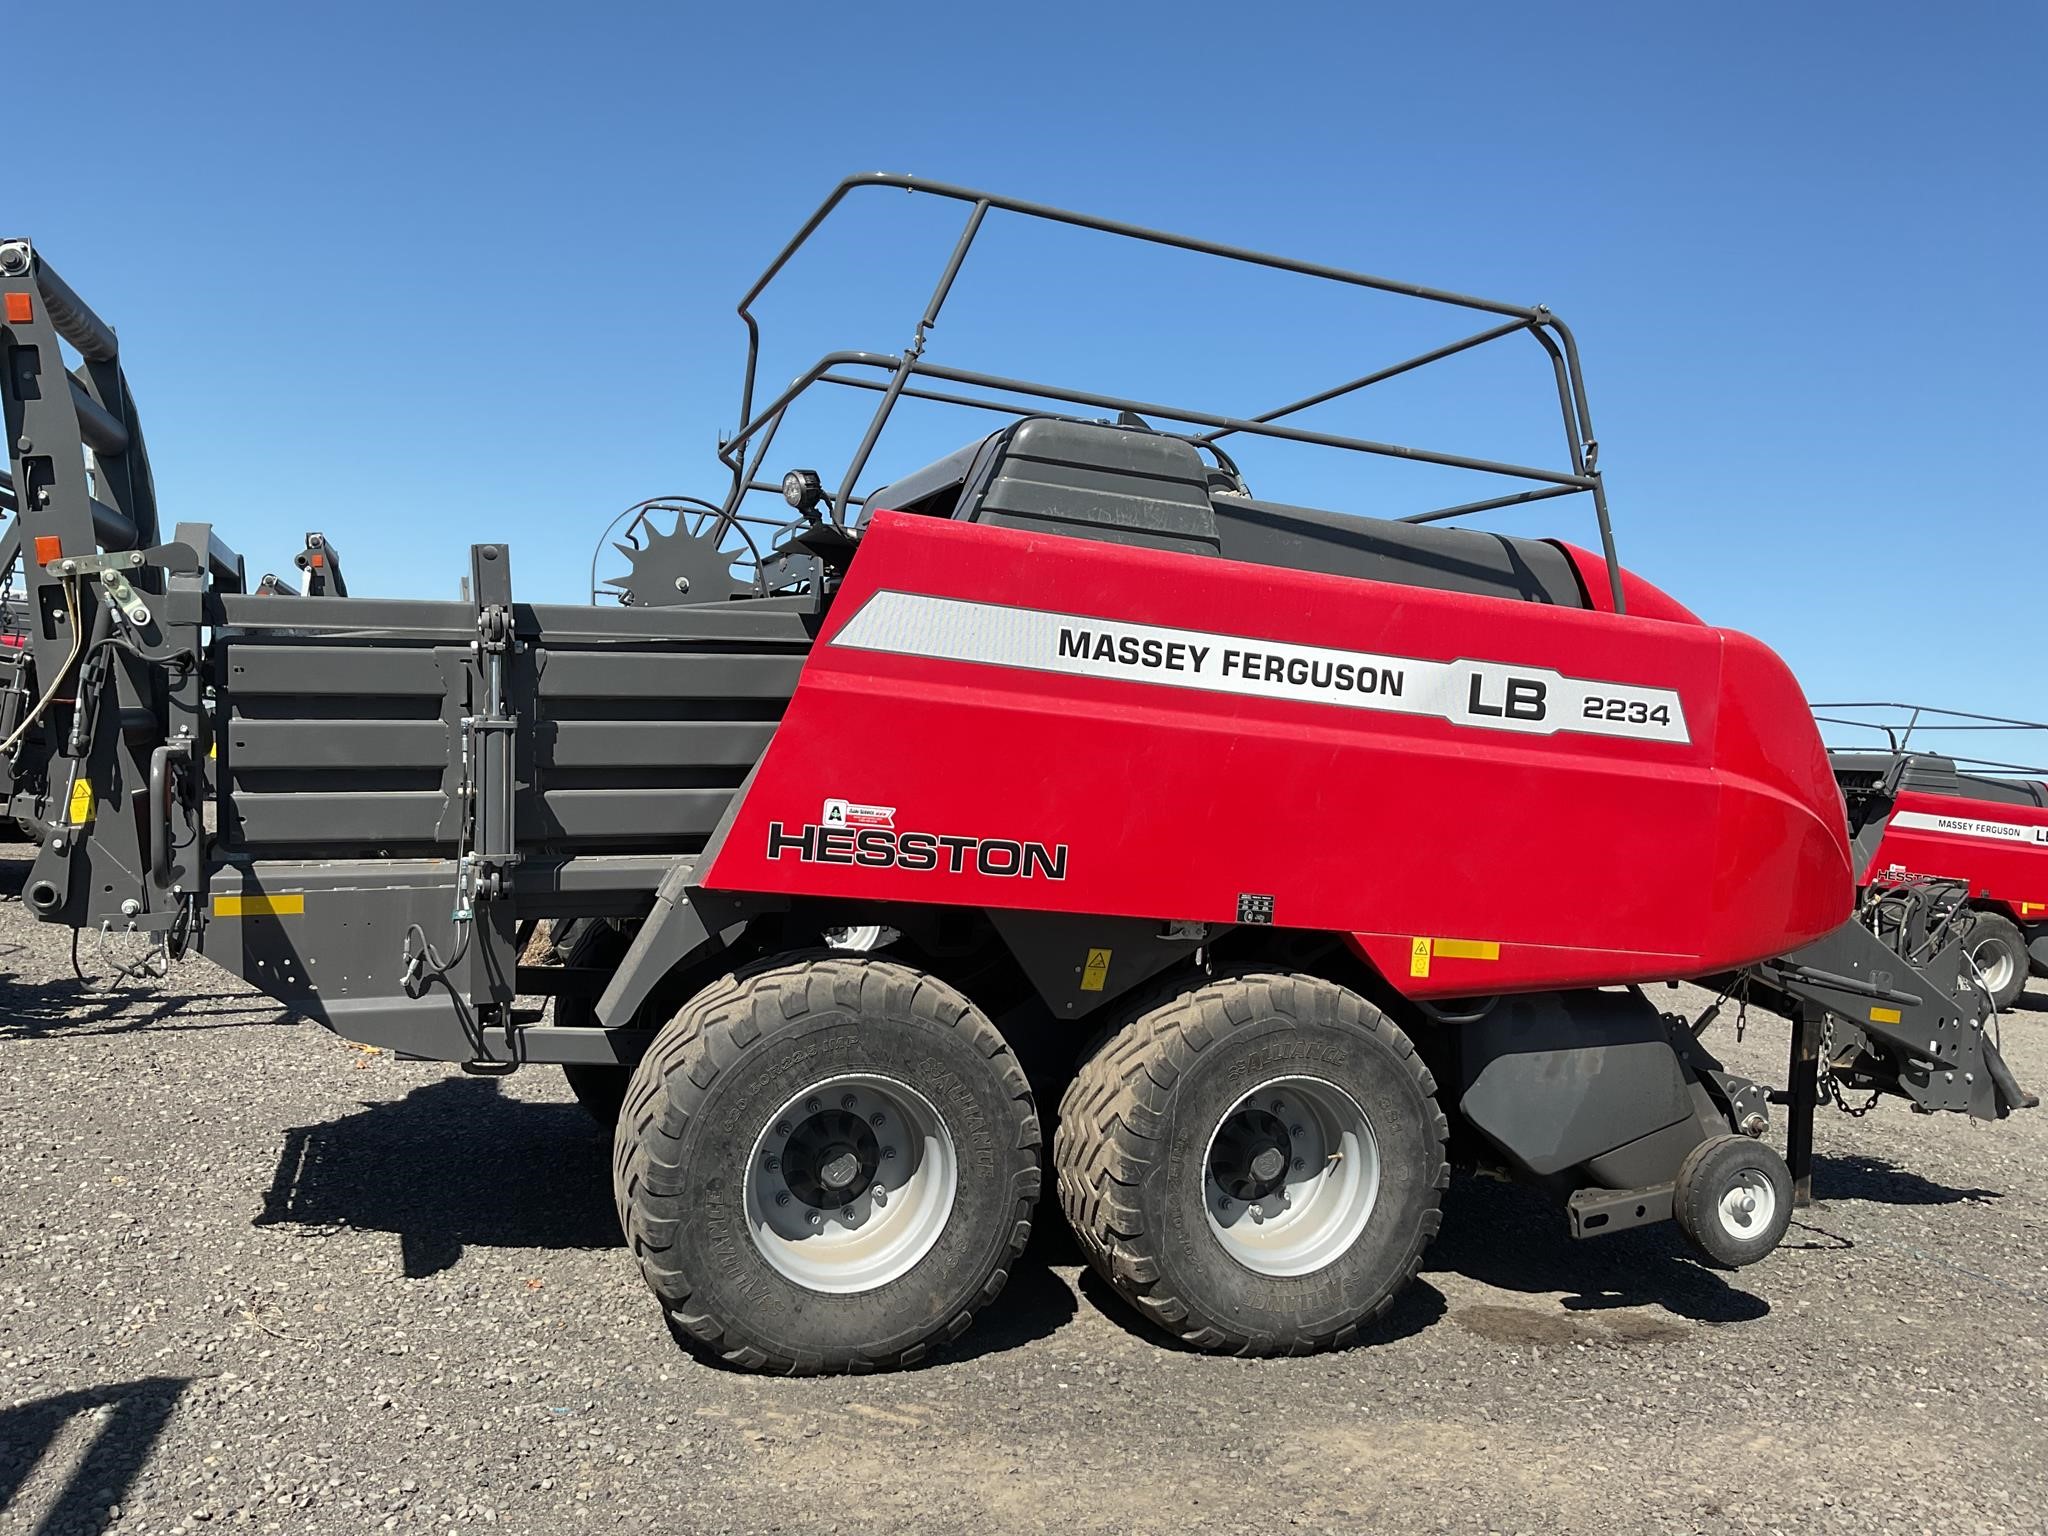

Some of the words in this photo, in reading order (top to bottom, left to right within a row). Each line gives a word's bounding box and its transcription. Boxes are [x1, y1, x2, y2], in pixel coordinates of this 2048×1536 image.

[1058, 628, 1211, 674] MASSEY
[1221, 647, 1405, 698] FERGUSON
[1468, 671, 1549, 722] LB
[1583, 696, 1672, 729] 2234
[766, 821, 1069, 880] HESSTON
[1938, 819, 1974, 832] MASSEY
[1975, 823, 2021, 837] FERGUSON
[1246, 1040, 1348, 1073] ALLIANCE
[932, 1071, 995, 1178] ALLIANCE
[705, 1189, 770, 1303] ALLIANCE
